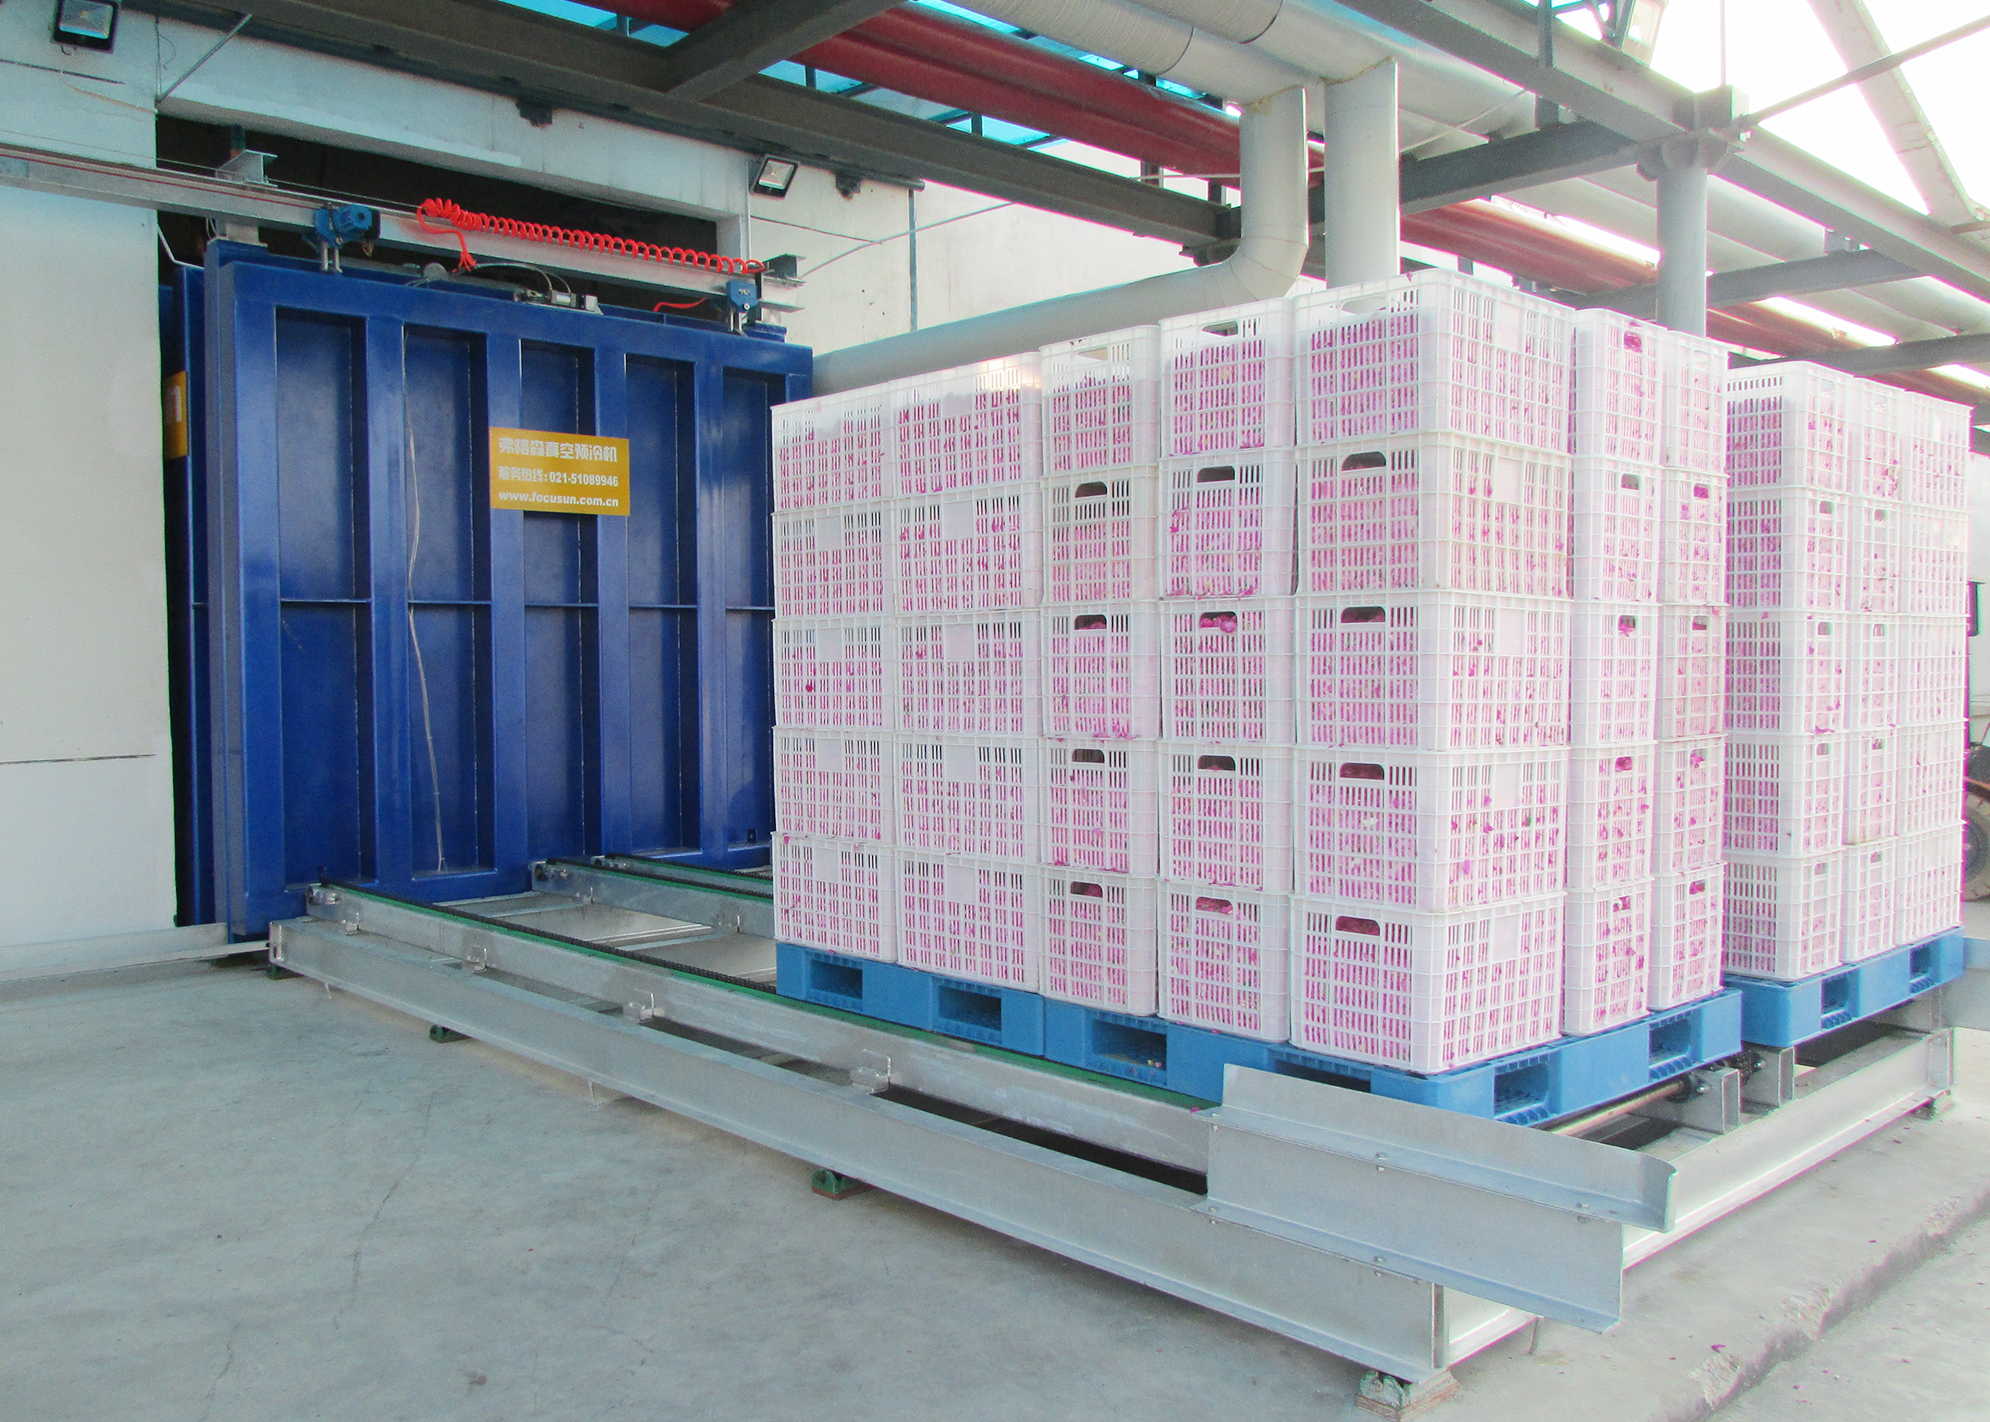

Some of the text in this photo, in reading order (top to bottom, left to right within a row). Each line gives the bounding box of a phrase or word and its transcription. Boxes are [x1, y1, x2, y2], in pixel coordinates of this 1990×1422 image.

[499, 438, 618, 462] 弗格森真空预冷机
[498, 491, 619, 507] www.focusun.com.cn
